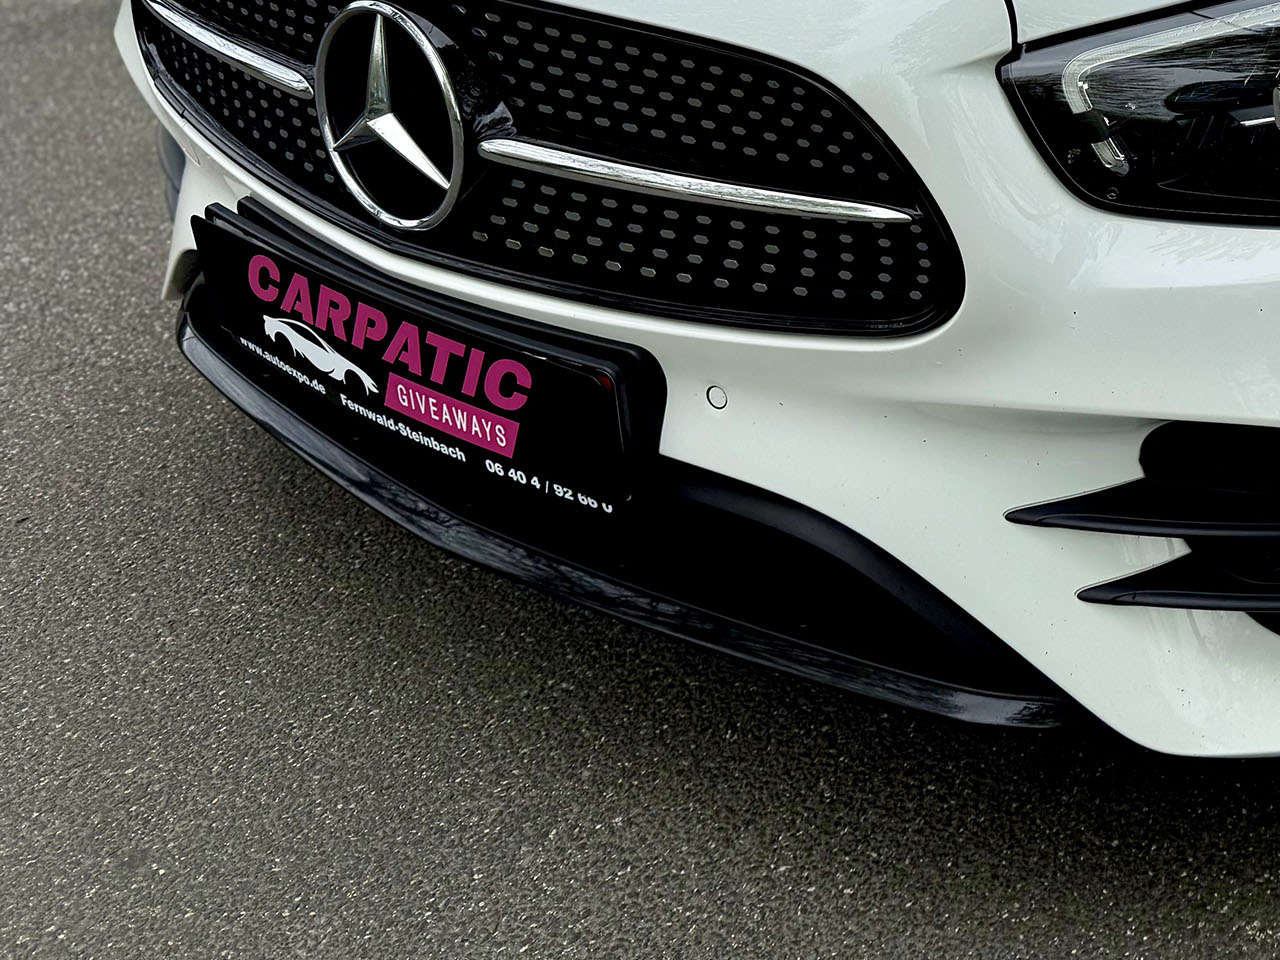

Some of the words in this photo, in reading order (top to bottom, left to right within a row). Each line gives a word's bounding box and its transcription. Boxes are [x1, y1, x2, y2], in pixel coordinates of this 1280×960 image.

[248, 254, 532, 410] CARPATIC
[239, 337, 326, 394] www.autoexpo.de
[340, 393, 466, 462] Fernwald-Steinbach
[397, 384, 507, 447] GIVEAWAYS
[485, 459, 505, 476] 06
[508, 468, 527, 484] 40
[530, 476, 541, 489] 4
[553, 483, 574, 500] 92
